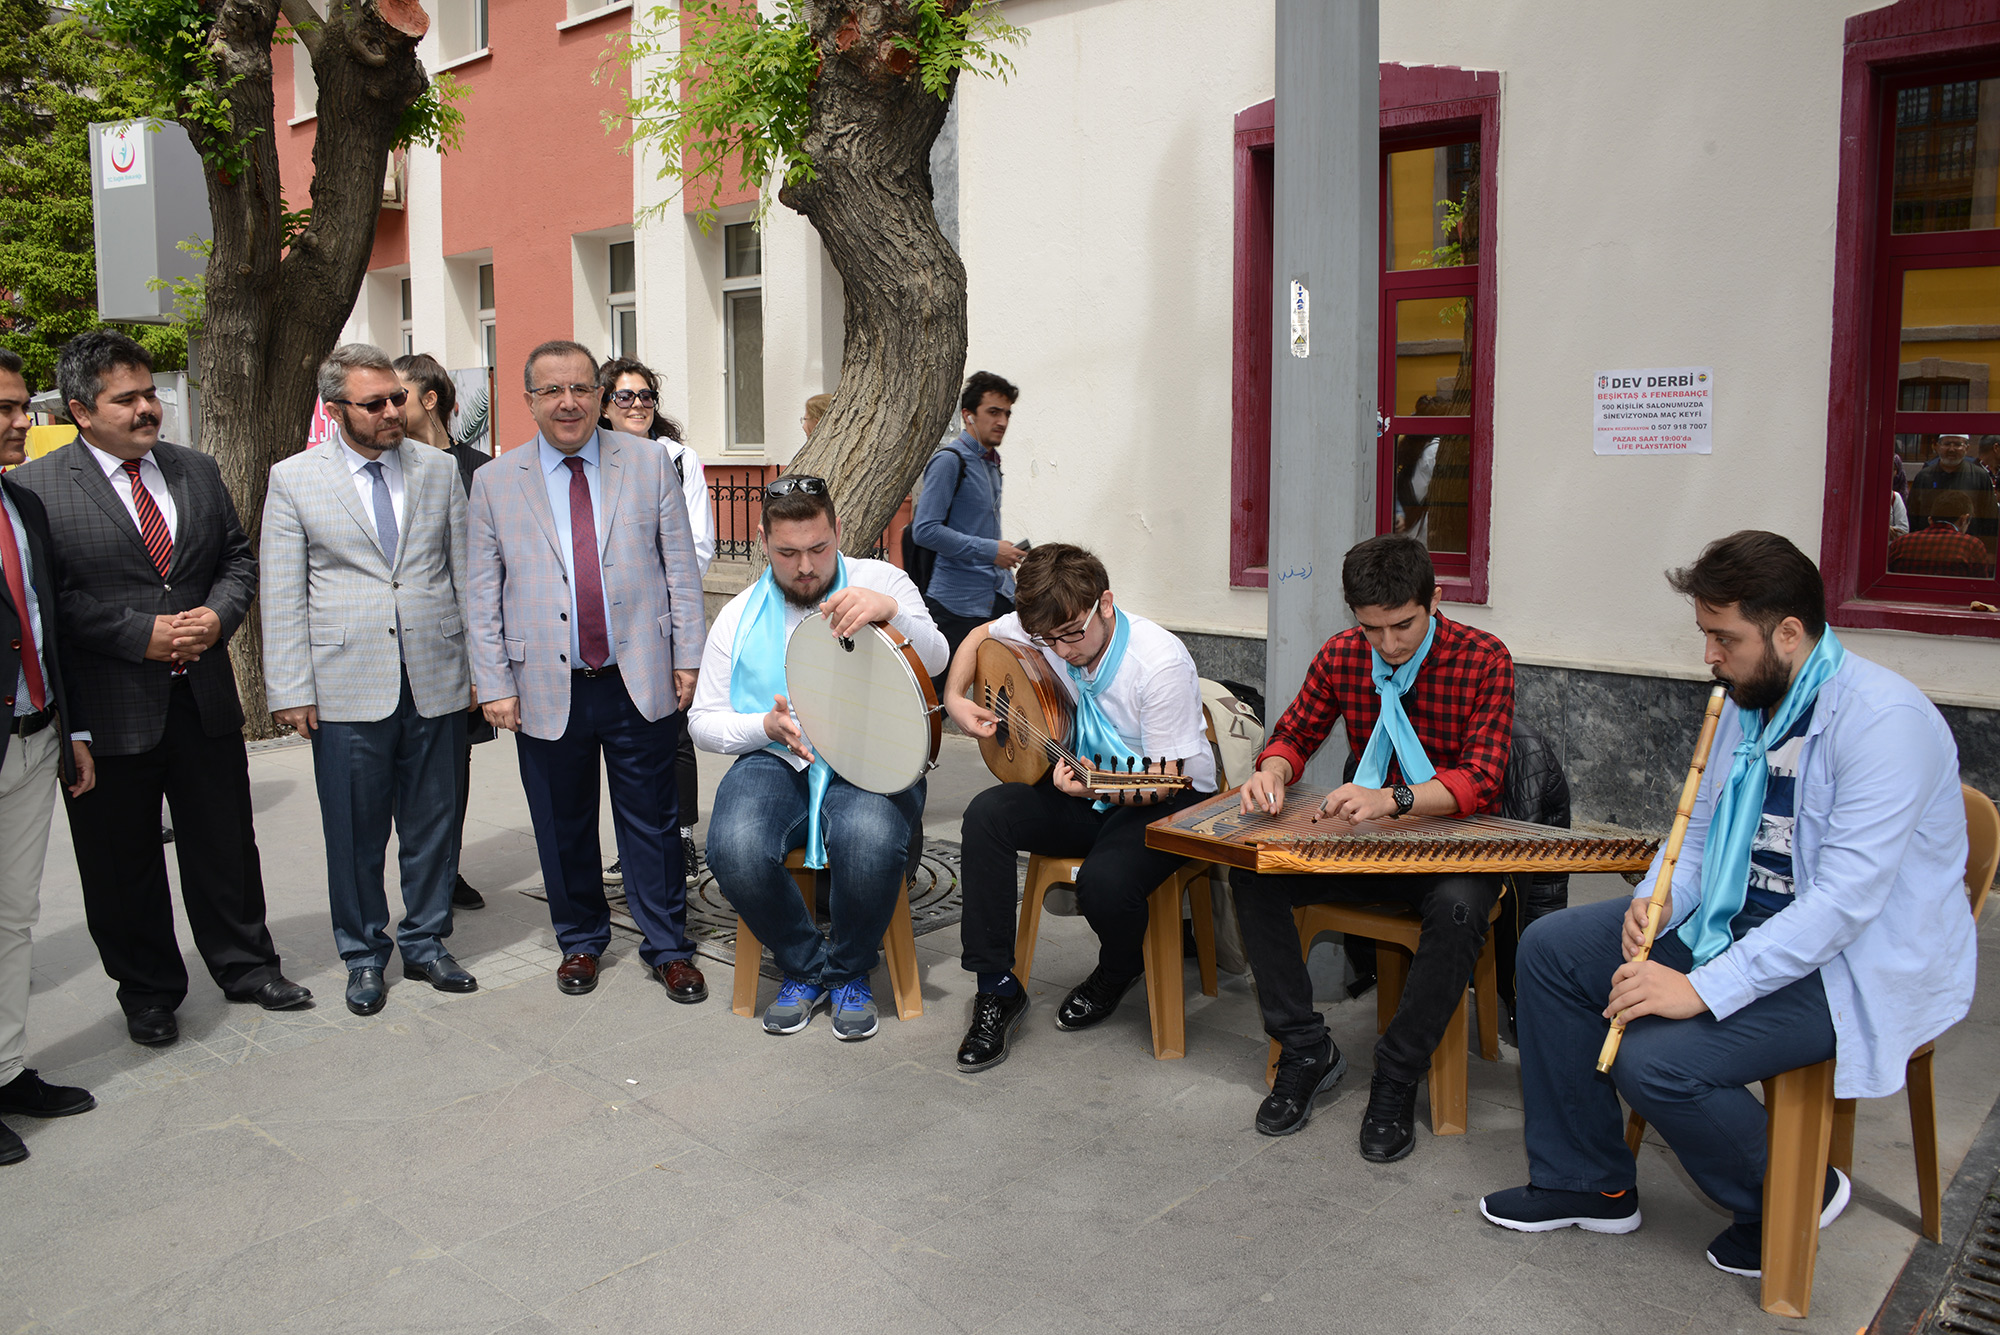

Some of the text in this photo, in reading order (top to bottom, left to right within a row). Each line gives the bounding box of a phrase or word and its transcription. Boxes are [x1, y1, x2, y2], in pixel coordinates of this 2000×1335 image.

[1612, 372, 1694, 389] DEV DERBİ
[1597, 389, 1709, 401] BEŞİKTAŞ & FENERBAHÇE
[1602, 401, 1704, 411] 500 KİŞİLİK SALONUMUZDA
[1603, 410, 1702, 420] SİNEVİZYONDA MAÇ KEYFİ
